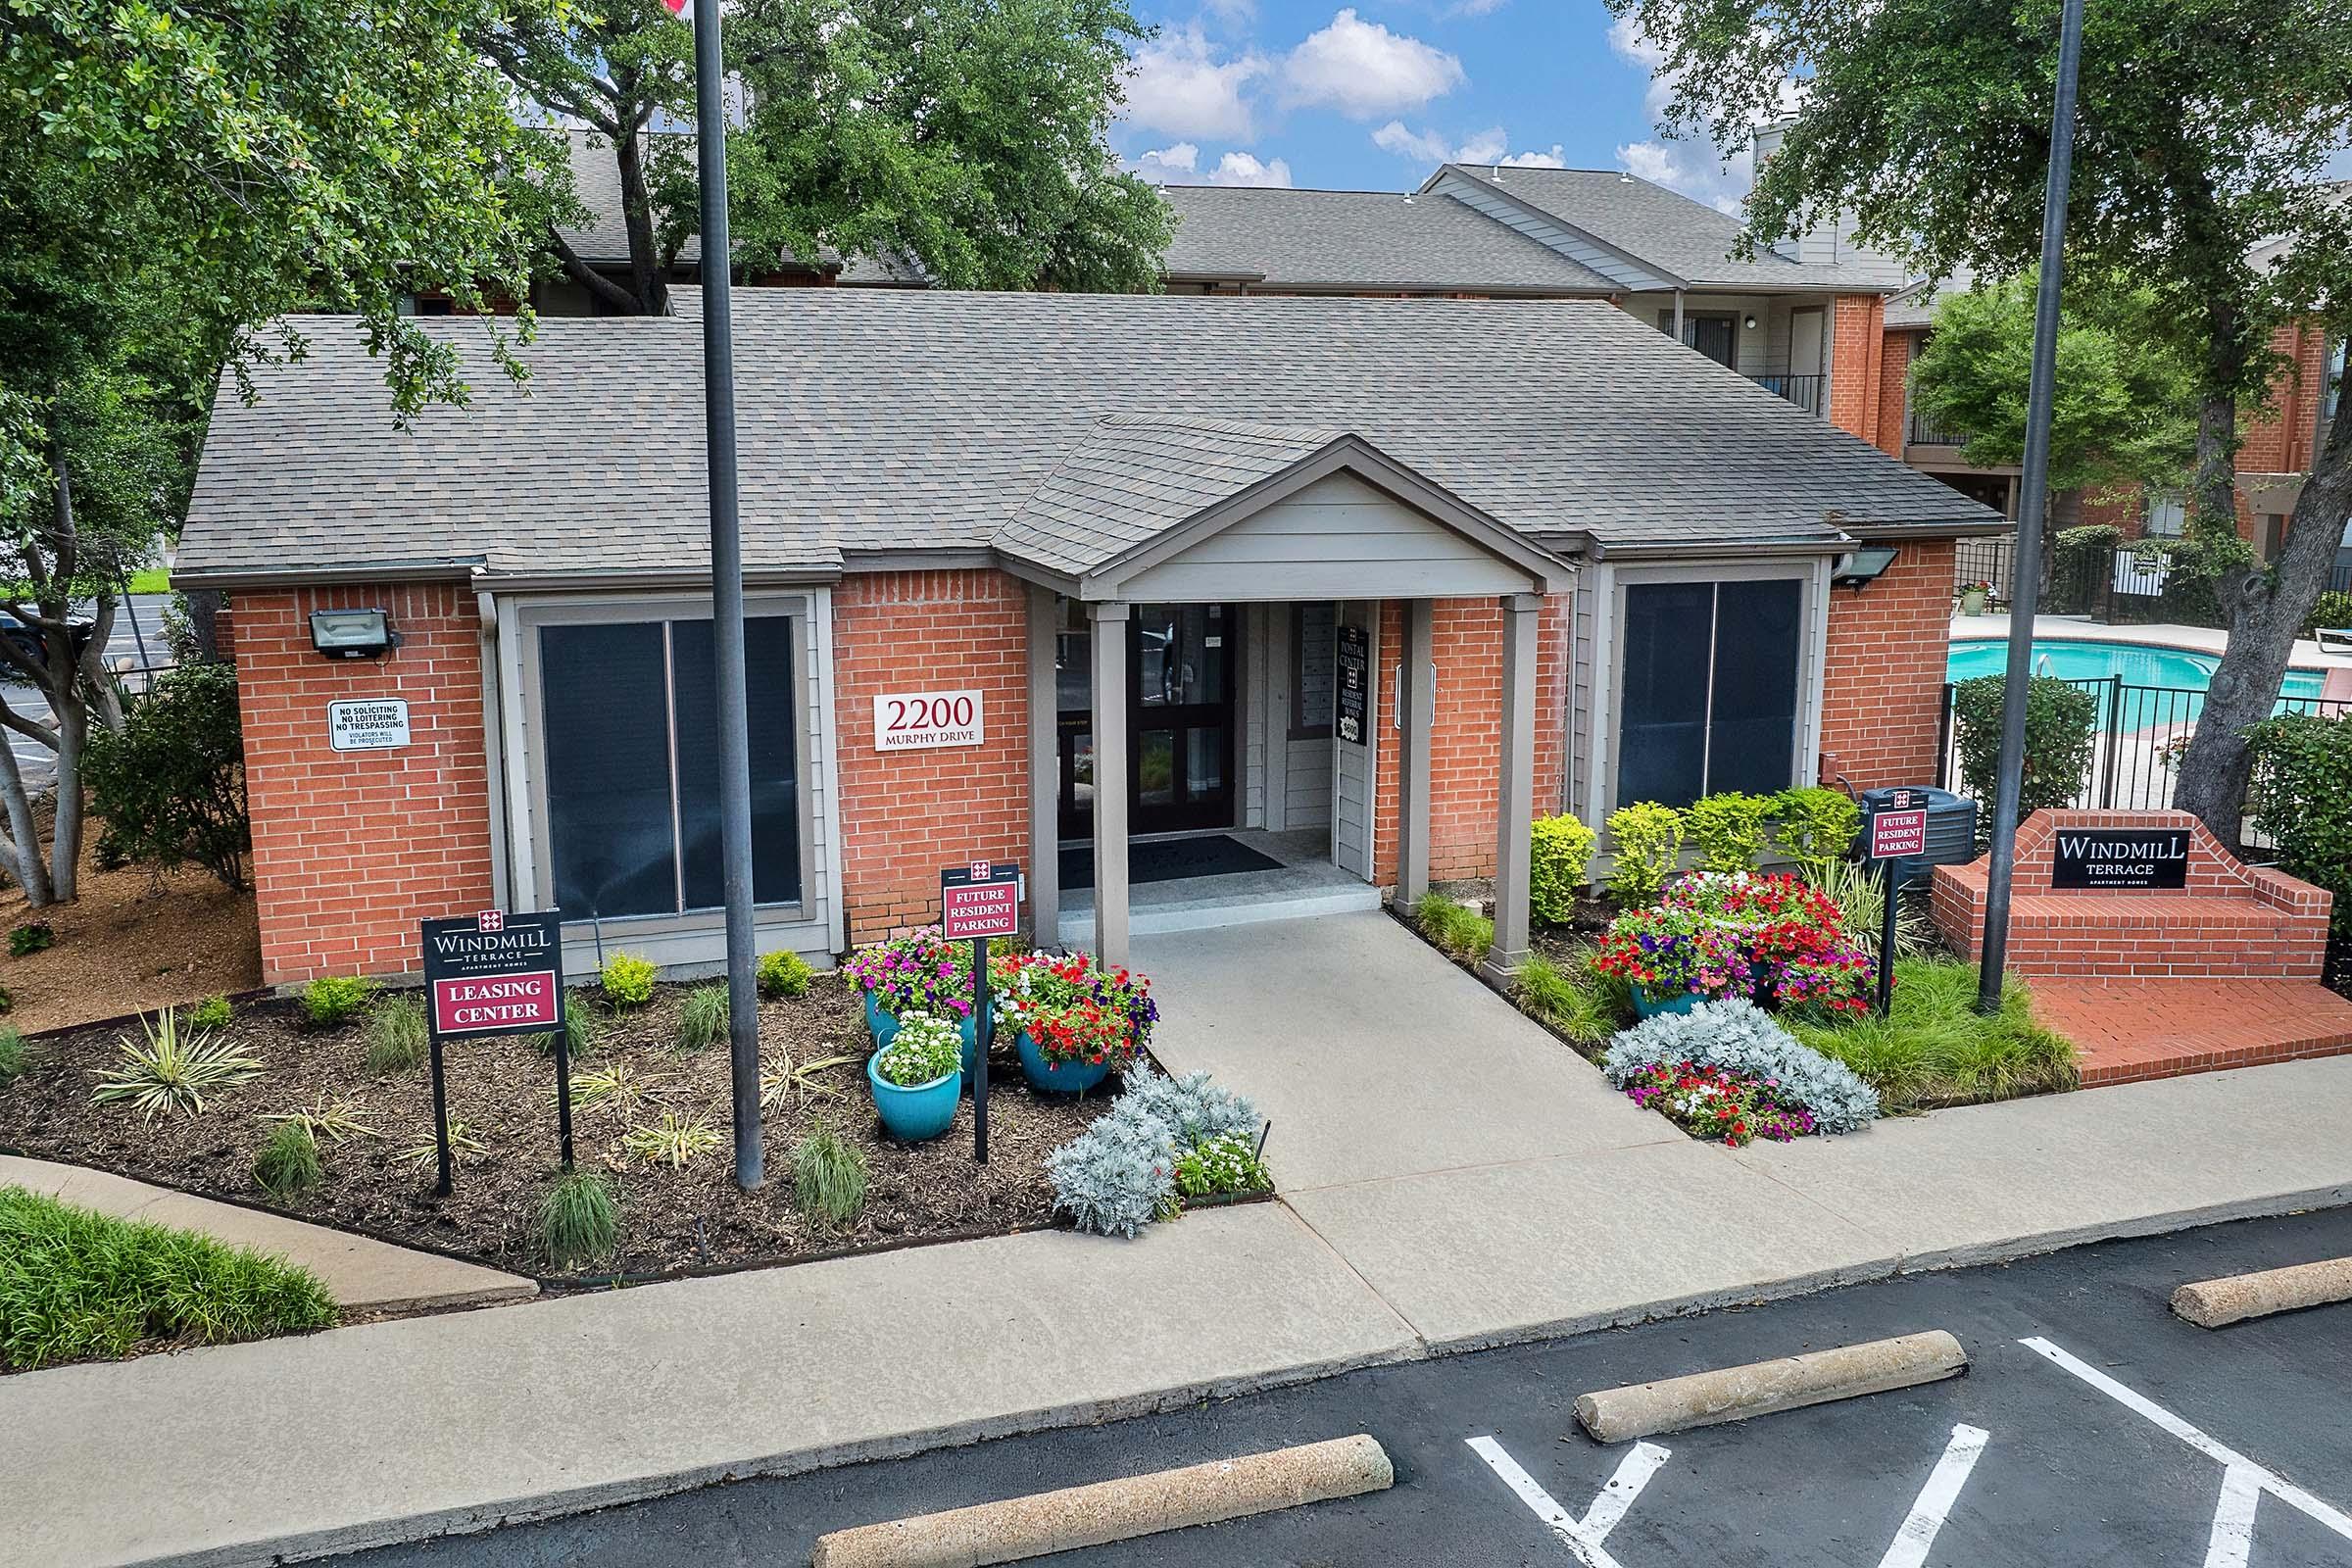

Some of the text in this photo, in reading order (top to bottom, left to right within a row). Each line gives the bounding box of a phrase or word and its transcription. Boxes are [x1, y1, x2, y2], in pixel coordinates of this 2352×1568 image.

[1342, 641, 1364, 658] POSTAL
[1339, 654, 1365, 671] CENTER
[354, 706, 398, 715] SOLICITING
[356, 713, 397, 722] LOITERING
[887, 696, 973, 731] 2200
[350, 720, 404, 730] TRESPASSING
[885, 730, 975, 745] MURPHY DRIVE
[1883, 815, 1919, 828] FUTURE
[1878, 827, 1922, 840] RESIDENT
[1879, 840, 1919, 853] PARKING
[2059, 836, 2185, 859] WINDMILL
[2086, 864, 2155, 875] TERRACE
[956, 889, 1005, 904] FUTURE
[950, 903, 1012, 918] RESIDENT
[953, 917, 1009, 933] PARKING
[433, 929, 552, 954] WINDMILL
[464, 951, 522, 962] TERRACE
[449, 980, 542, 1002] LEASING
[454, 1003, 540, 1023] CENTER
